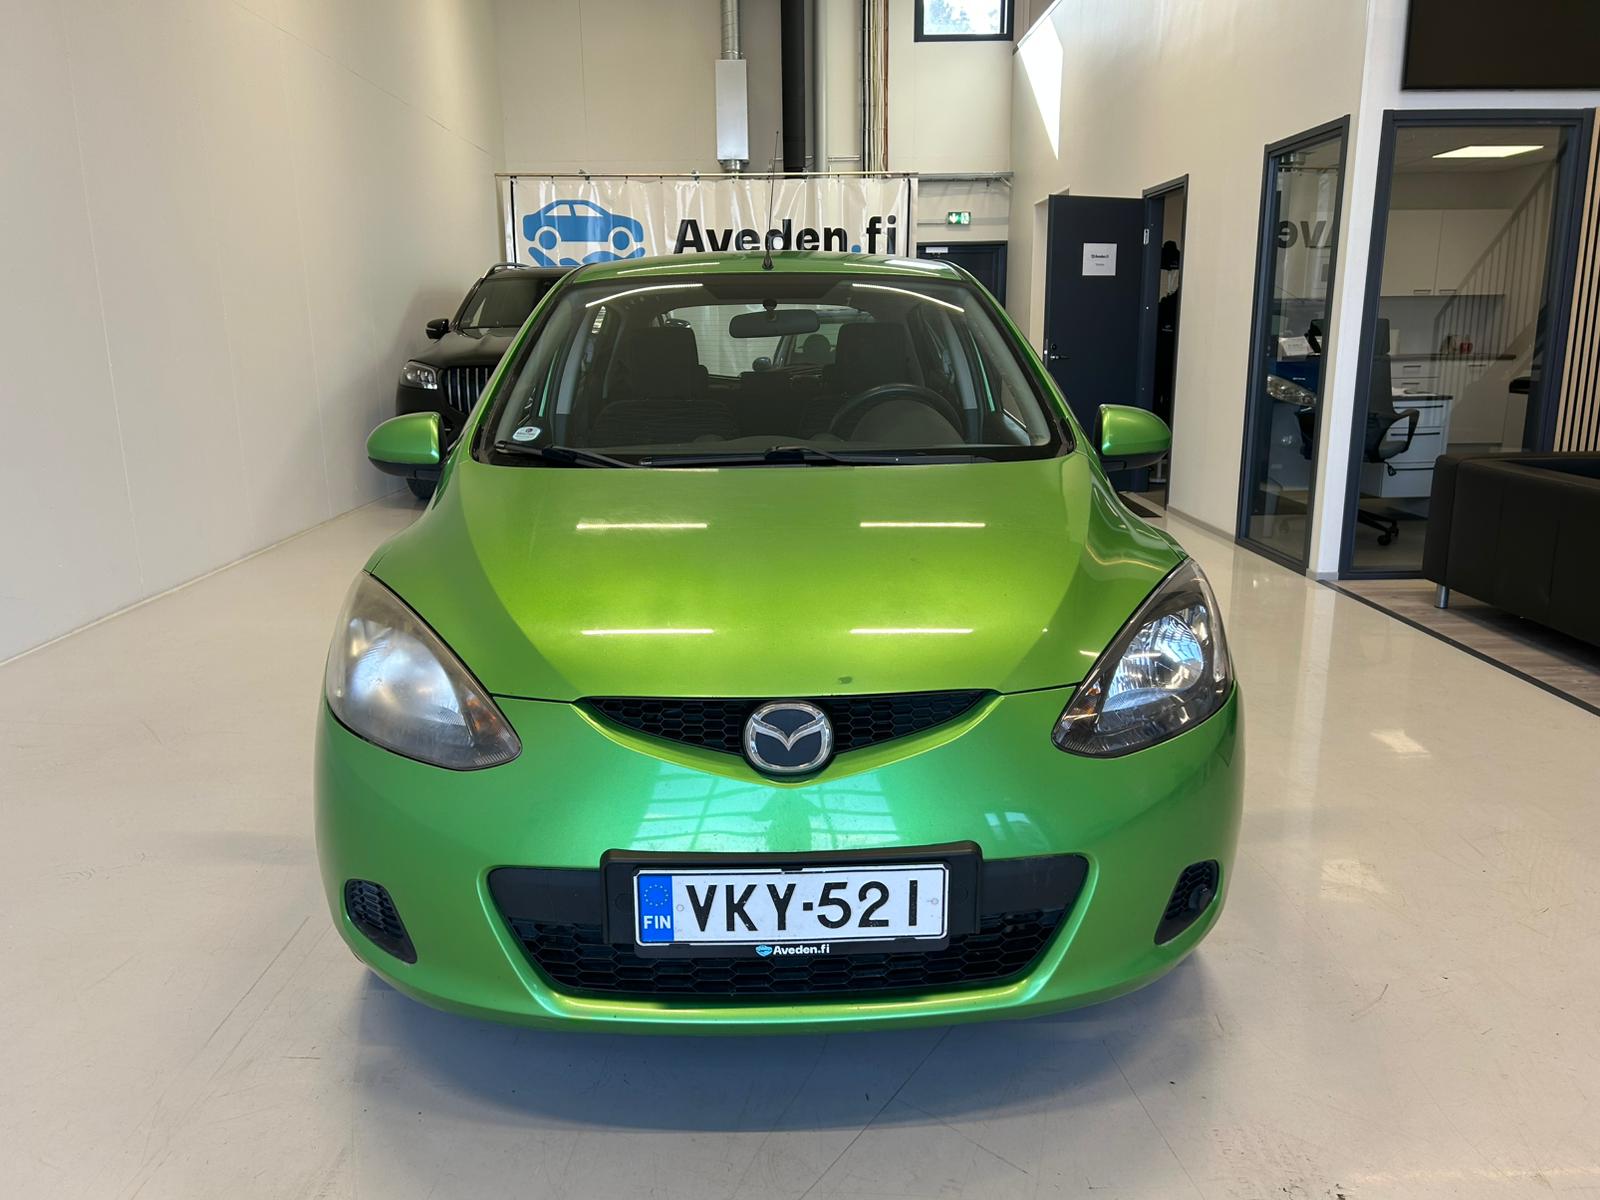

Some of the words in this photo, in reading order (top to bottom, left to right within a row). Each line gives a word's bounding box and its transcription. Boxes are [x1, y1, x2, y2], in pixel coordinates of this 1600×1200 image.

[674, 215, 897, 254] Aveden.fi
[685, 880, 918, 932] VKY-521
[643, 915, 672, 930] FIN
[773, 943, 830, 956] Aveden.fi
